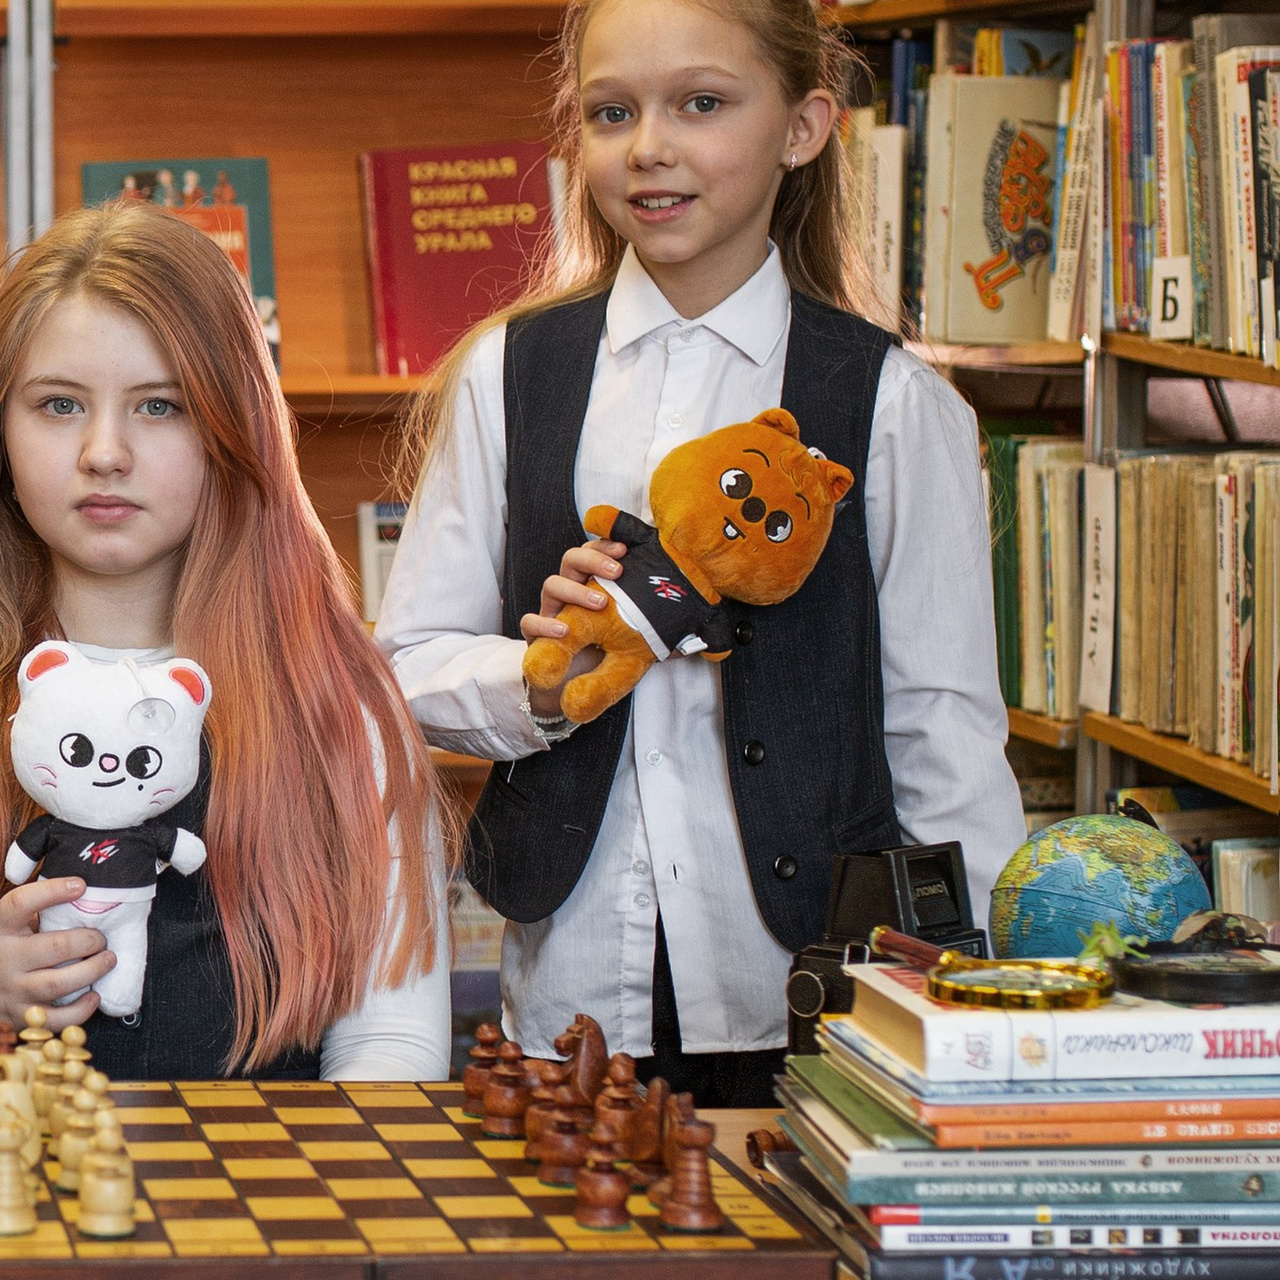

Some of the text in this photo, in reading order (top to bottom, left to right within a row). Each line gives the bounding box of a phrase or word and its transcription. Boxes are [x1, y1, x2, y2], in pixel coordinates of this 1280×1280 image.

[407, 156, 518, 183] КРАСНАЯ
[409, 183, 489, 207] КНИГА
[411, 202, 538, 231] СРЕДНЕГО
[413, 230, 494, 255] УРАЛА
[1161, 276, 1179, 323] Б
[1202, 1029, 1280, 1060] ЧНИК
[1020, 1182, 1103, 1197] РУССКОЙ
[1110, 1181, 1184, 1195] АЗБУКА
[1031, 1257, 1056, 1271] от
[1062, 1257, 1211, 1277] художники
